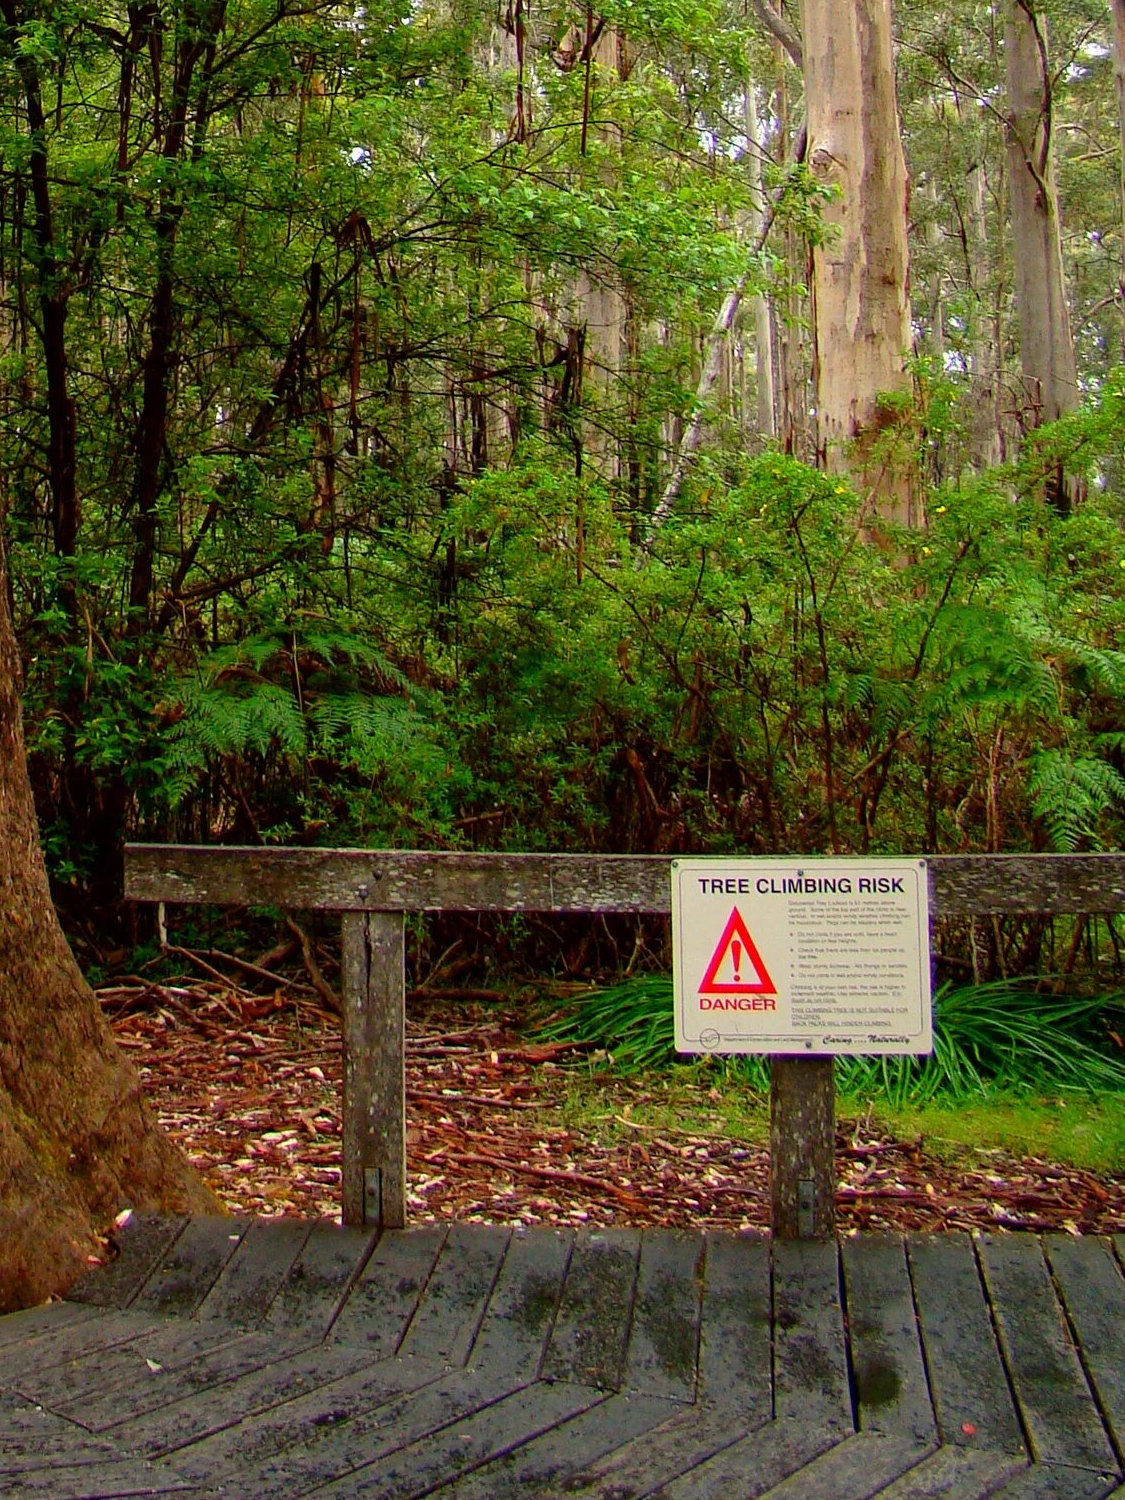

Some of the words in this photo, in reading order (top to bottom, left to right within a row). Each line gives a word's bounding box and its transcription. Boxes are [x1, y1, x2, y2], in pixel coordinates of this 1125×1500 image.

[698, 878, 750, 894] TREE
[756, 878, 852, 894] CLIMBING
[858, 877, 904, 893] RISK
[699, 998, 776, 1011] DANGER
[822, 1034, 852, 1045] Caring
[867, 1033, 911, 1045] Naturally
